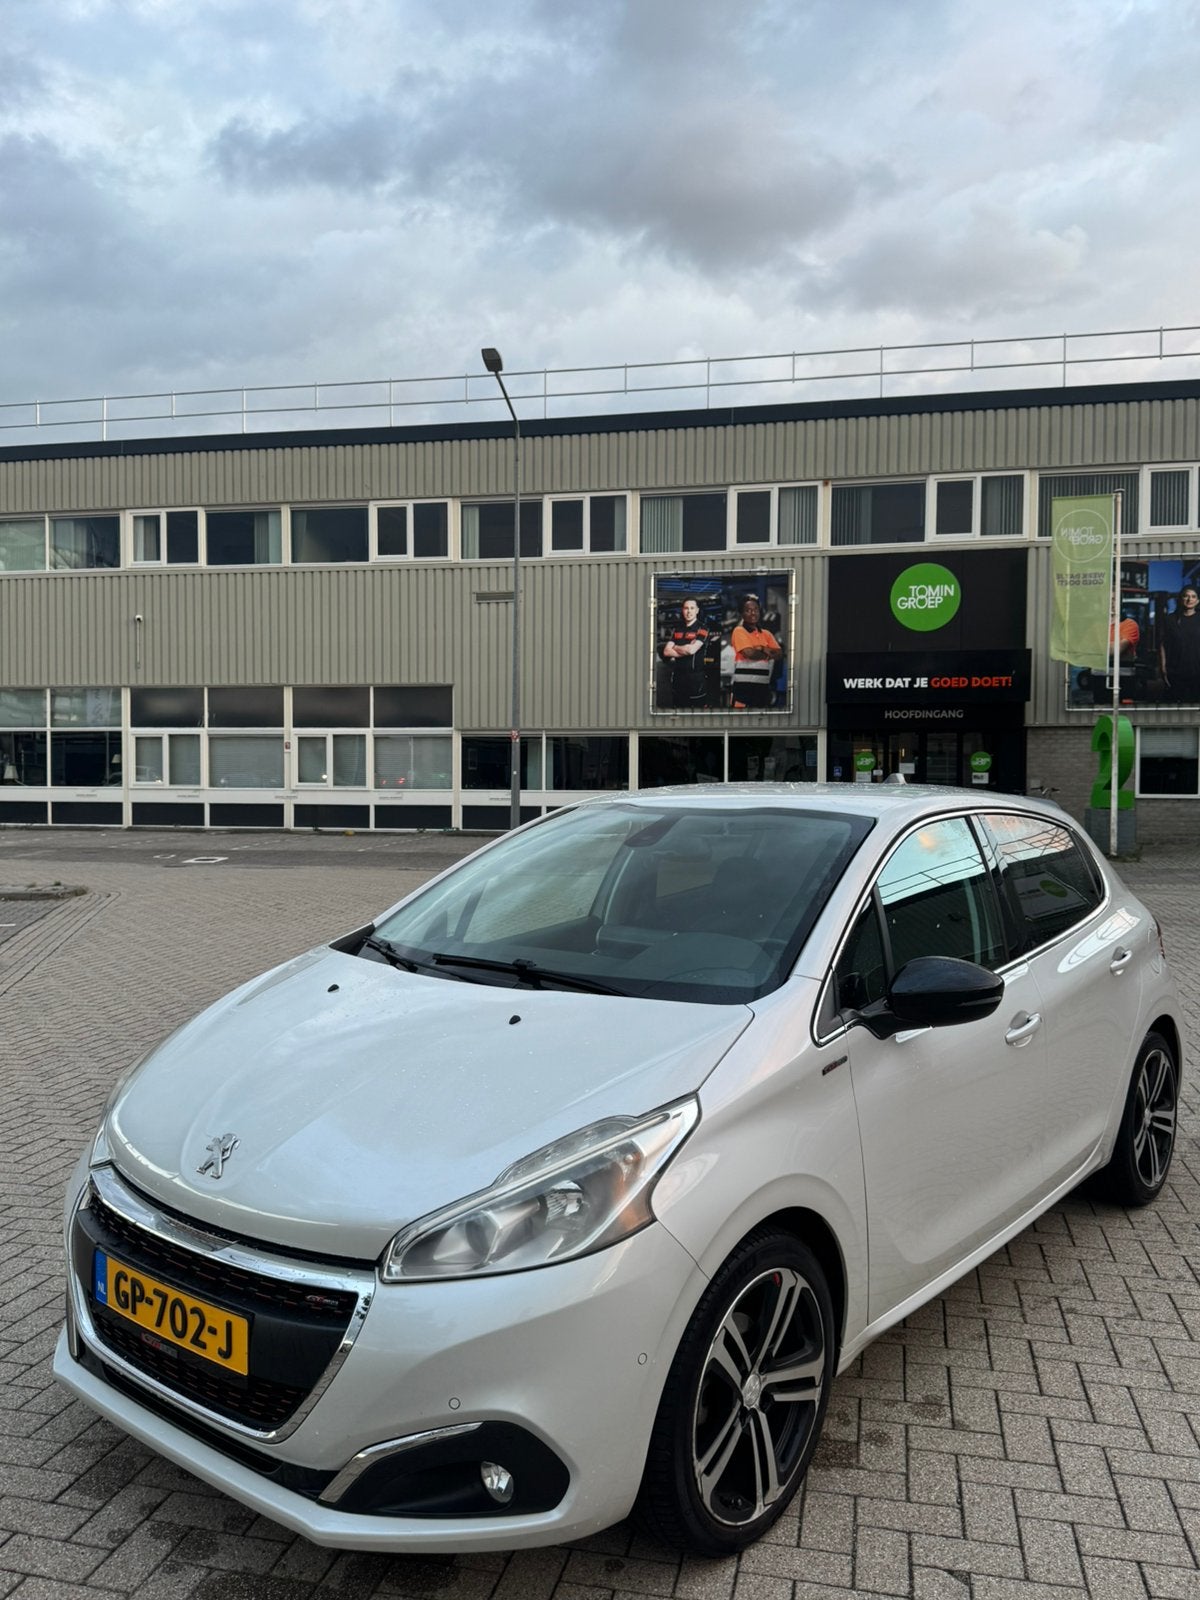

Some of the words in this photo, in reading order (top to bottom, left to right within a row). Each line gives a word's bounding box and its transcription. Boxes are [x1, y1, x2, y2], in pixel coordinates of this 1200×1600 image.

[909, 584, 955, 597] TOMIN
[897, 596, 943, 610] GROEP
[843, 678, 883, 689] WERK
[885, 677, 911, 688] DAT
[913, 677, 928, 688] JE
[930, 677, 968, 688] GOED
[971, 676, 1012, 688] DOET!
[884, 709, 964, 719] HOOFDINGANG
[97, 1280, 106, 1295] NL
[114, 1270, 233, 1360] GP-702-J
